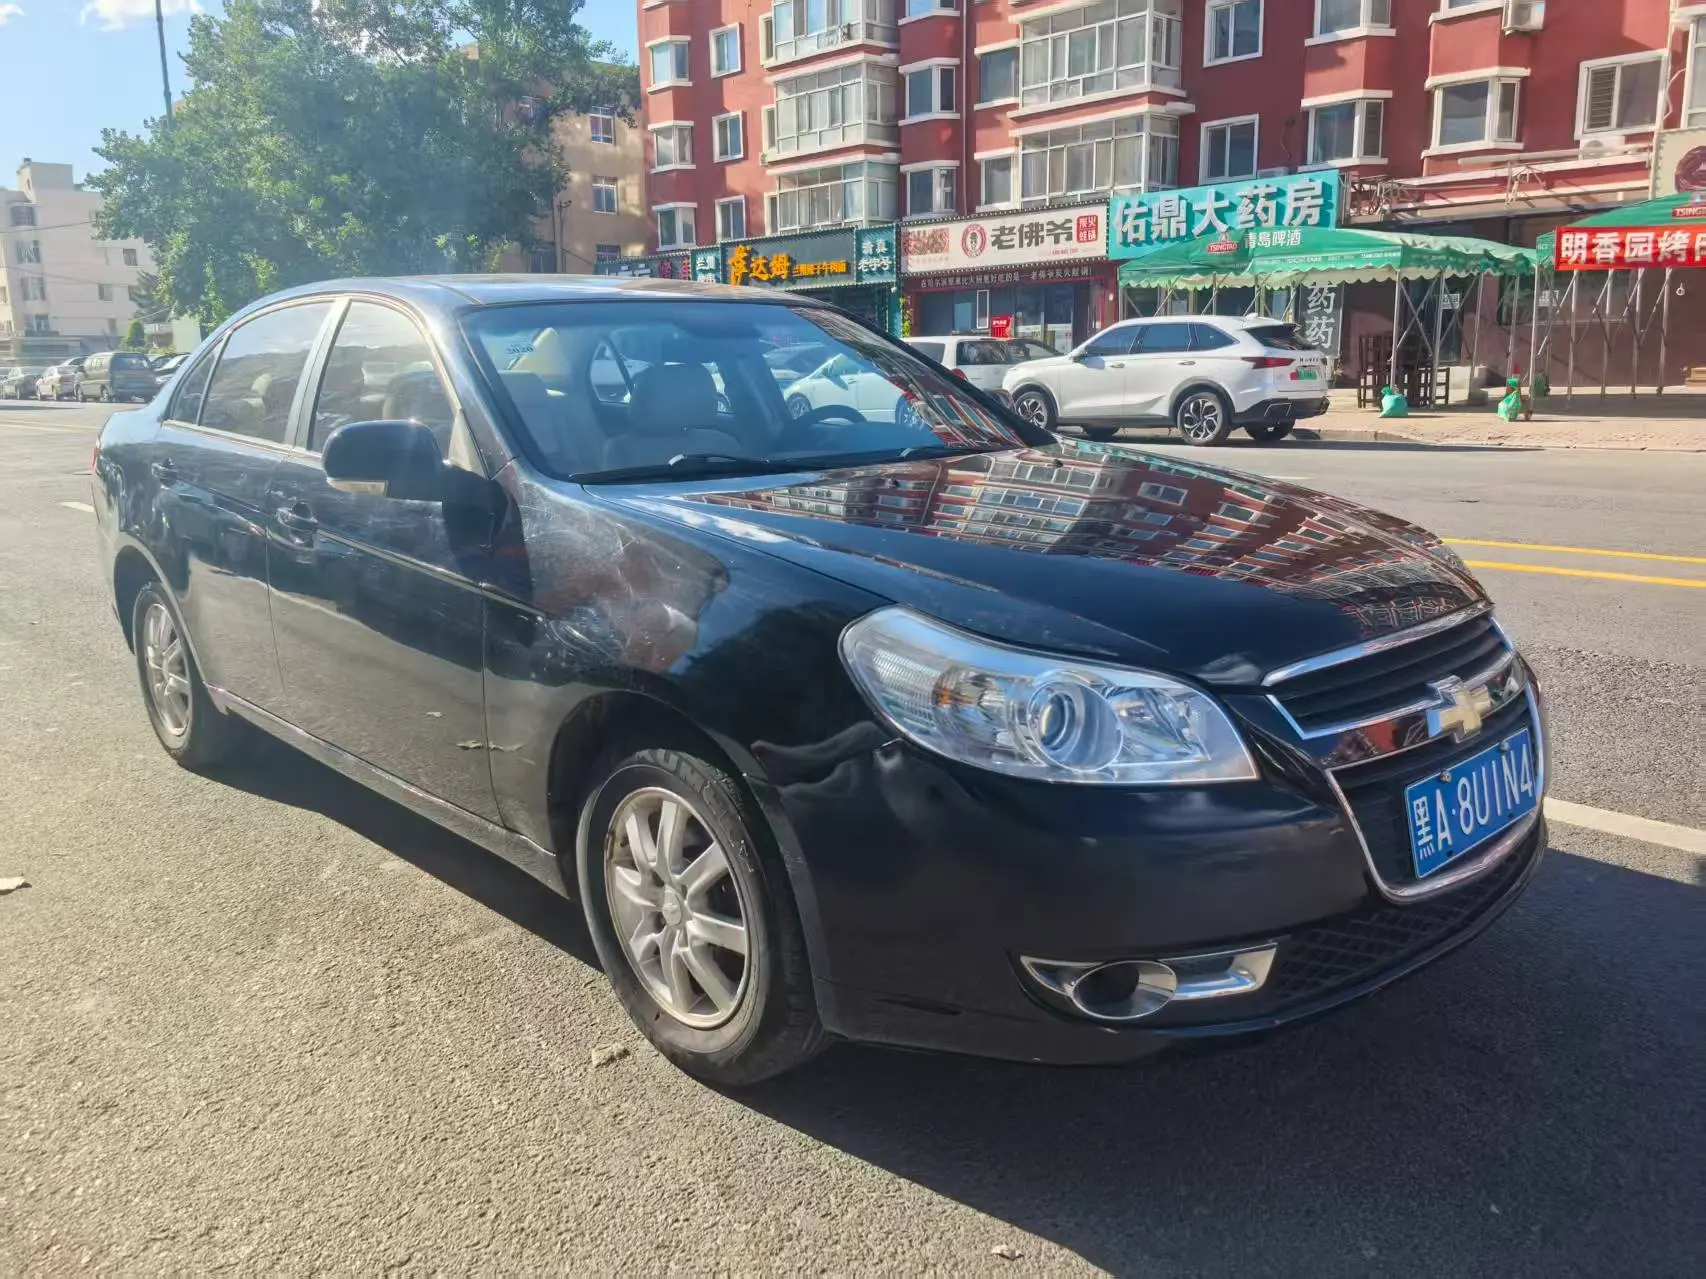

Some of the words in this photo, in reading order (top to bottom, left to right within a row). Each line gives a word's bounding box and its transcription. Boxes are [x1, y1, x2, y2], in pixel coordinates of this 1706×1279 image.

[1113, 177, 1325, 244] 佑鼎大药房
[991, 218, 1073, 251] 老佛爷
[1209, 241, 1238, 253] TSINGTAO
